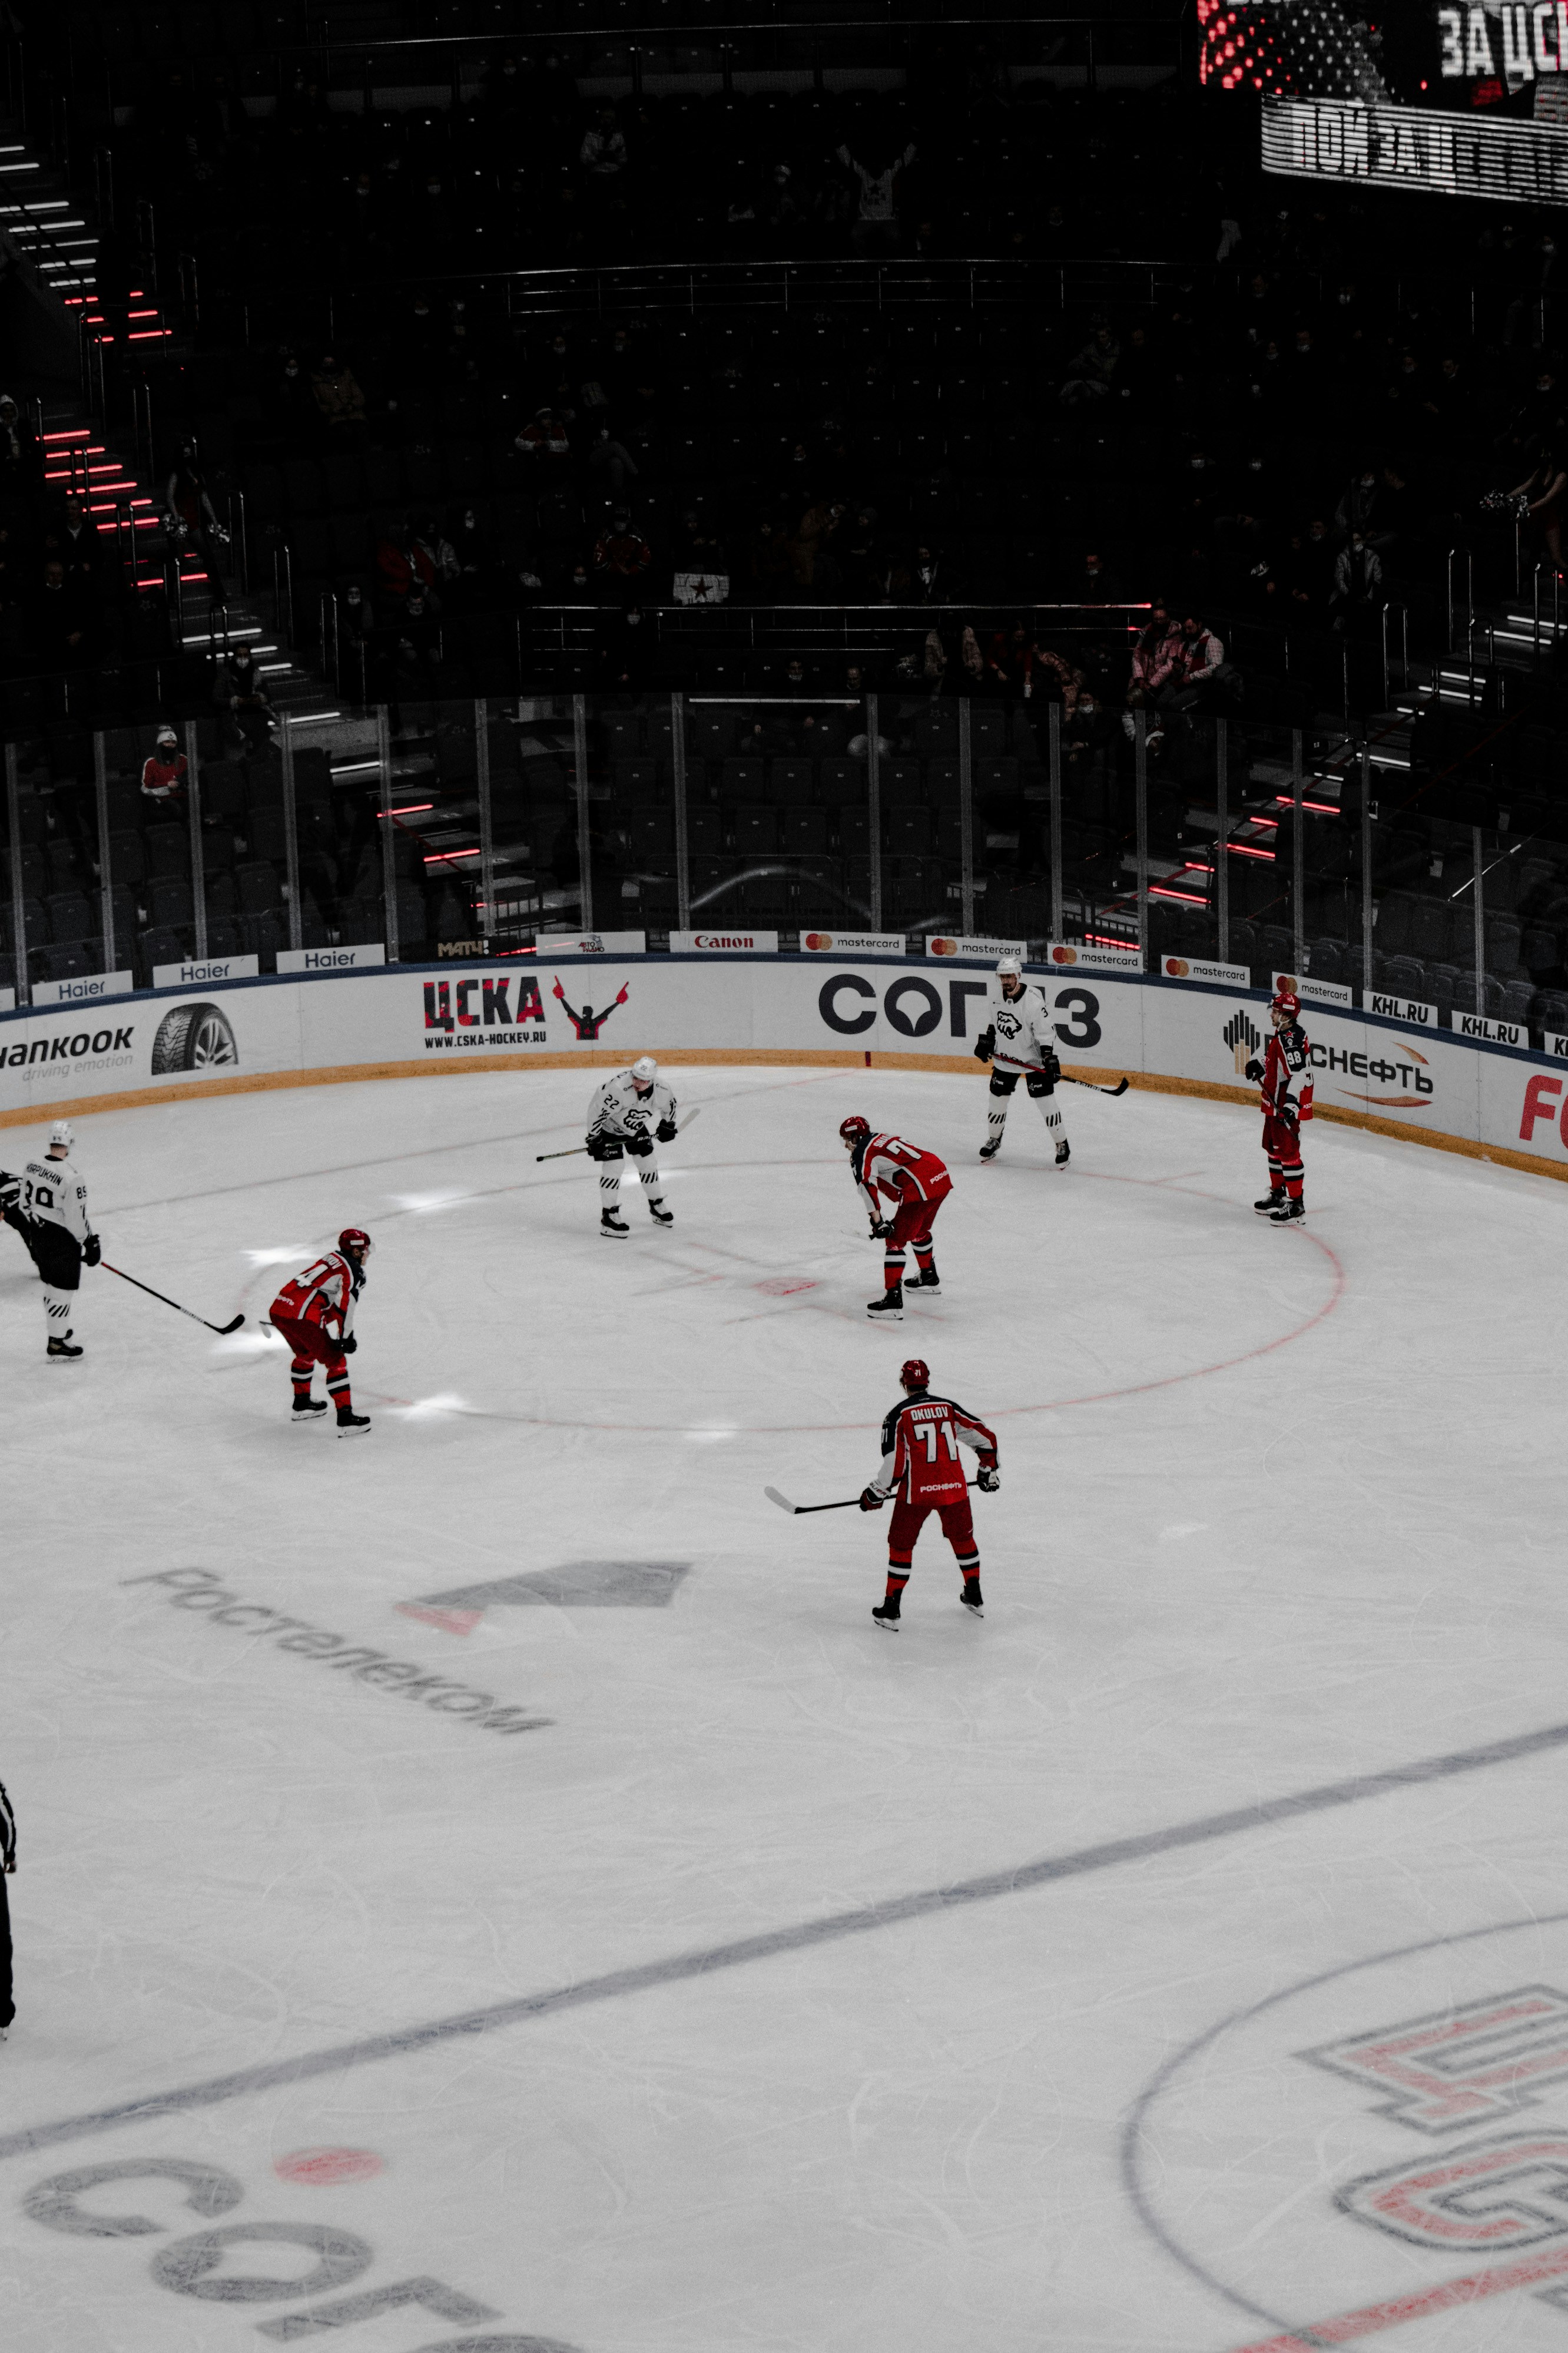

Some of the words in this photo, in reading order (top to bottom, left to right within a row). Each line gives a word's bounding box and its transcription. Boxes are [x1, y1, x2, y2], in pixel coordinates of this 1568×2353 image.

[694, 935, 754, 949] Canon
[838, 938, 899, 948] mastercard
[962, 943, 1021, 955] mastercard
[305, 952, 356, 969] Haier
[1082, 952, 1138, 967] mastercard
[181, 963, 230, 982] Haier
[1193, 965, 1245, 981] mastercard
[59, 981, 105, 1000] Haier
[1302, 983, 1347, 1001] mastercard
[424, 976, 546, 1033] ЦСКА
[818, 974, 1102, 1048] СОГЗ
[1372, 995, 1428, 1024] KHL.RU
[1461, 1016, 1519, 1045] KHL.RU
[425, 1031, 546, 1048] WWW.CSKA-HOCKEY.RU
[1287, 1051, 1302, 1065] 98
[22, 1064, 70, 1081] driving
[75, 1055, 133, 1073] emotion
[604, 1094, 619, 1110] 22
[911, 1406, 948, 1421] OKULOV
[913, 1420, 958, 1463] 71
[920, 1482, 962, 1493] РОСНЕФТЬ
